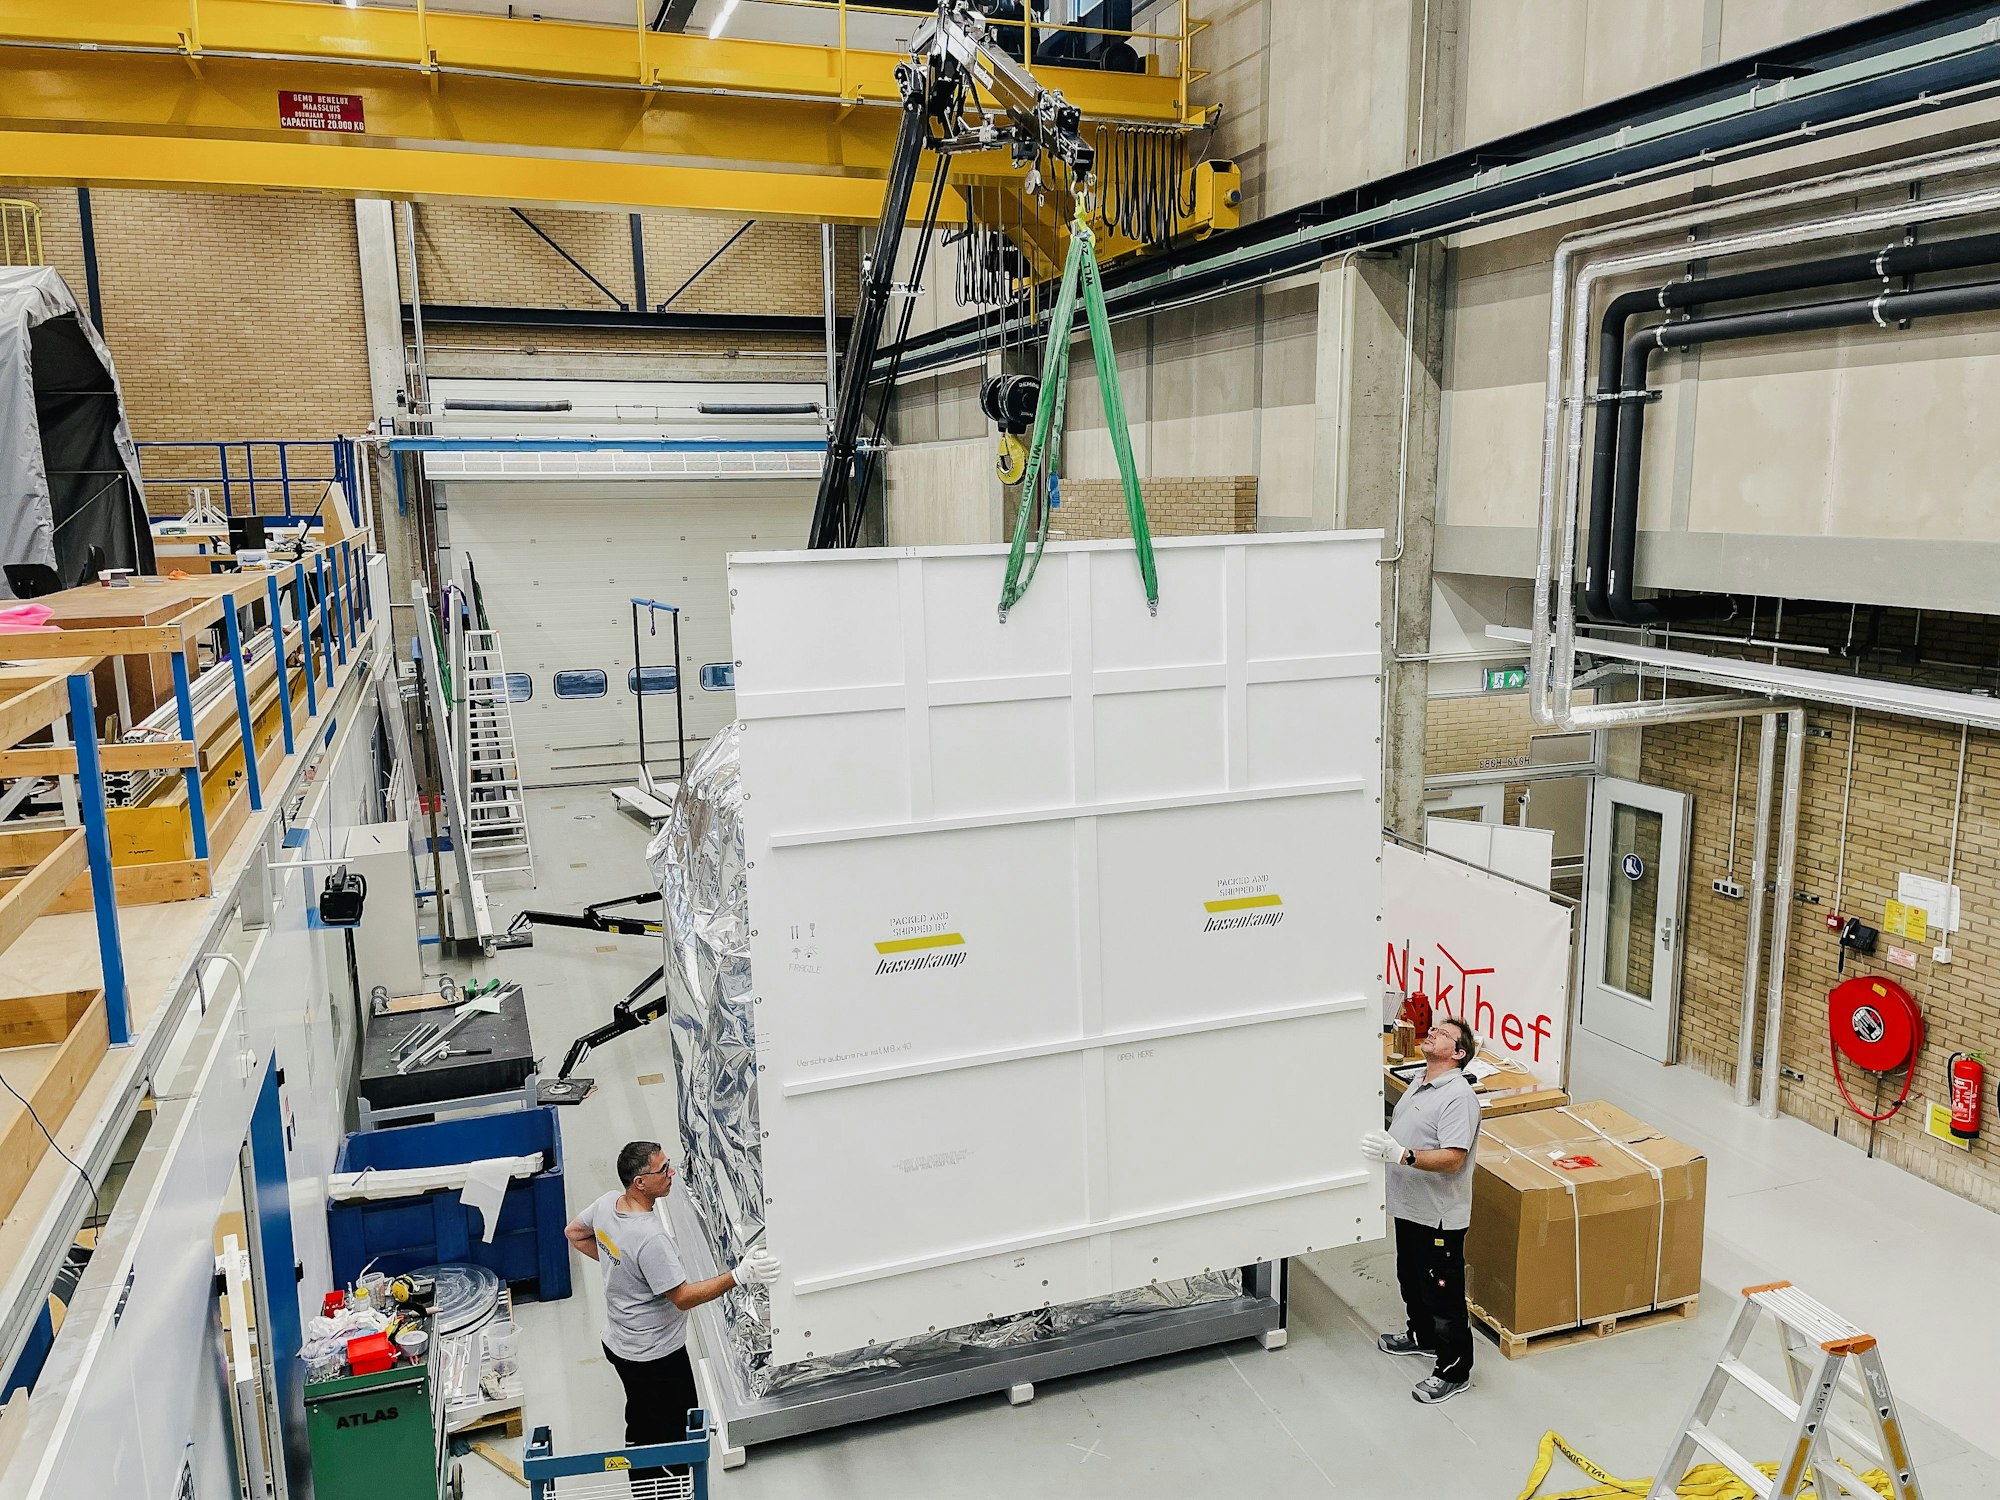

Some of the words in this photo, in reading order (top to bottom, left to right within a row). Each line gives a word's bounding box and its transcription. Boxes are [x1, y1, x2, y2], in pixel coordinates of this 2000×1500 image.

[317, 96, 349, 105] BENELUX
[302, 103, 341, 113] MAASSLUIS
[281, 117, 325, 128] CAPACITEIT
[327, 120, 352, 130] 20.000
[353, 122, 364, 131] KG
[1217, 876, 1250, 888] PACKED
[1252, 874, 1269, 883] AND
[1219, 885, 1254, 897] SHIPPED
[1256, 884, 1267, 893] BY
[889, 914, 927, 927] PACKED
[929, 911, 949, 922] AND
[1203, 912, 1284, 933] hasenkamp
[893, 924, 932, 937] SHIPPED
[934, 922, 947, 932] BY
[875, 952, 967, 976] hasenkamp
[336, 1406, 399, 1430] ATLAS
